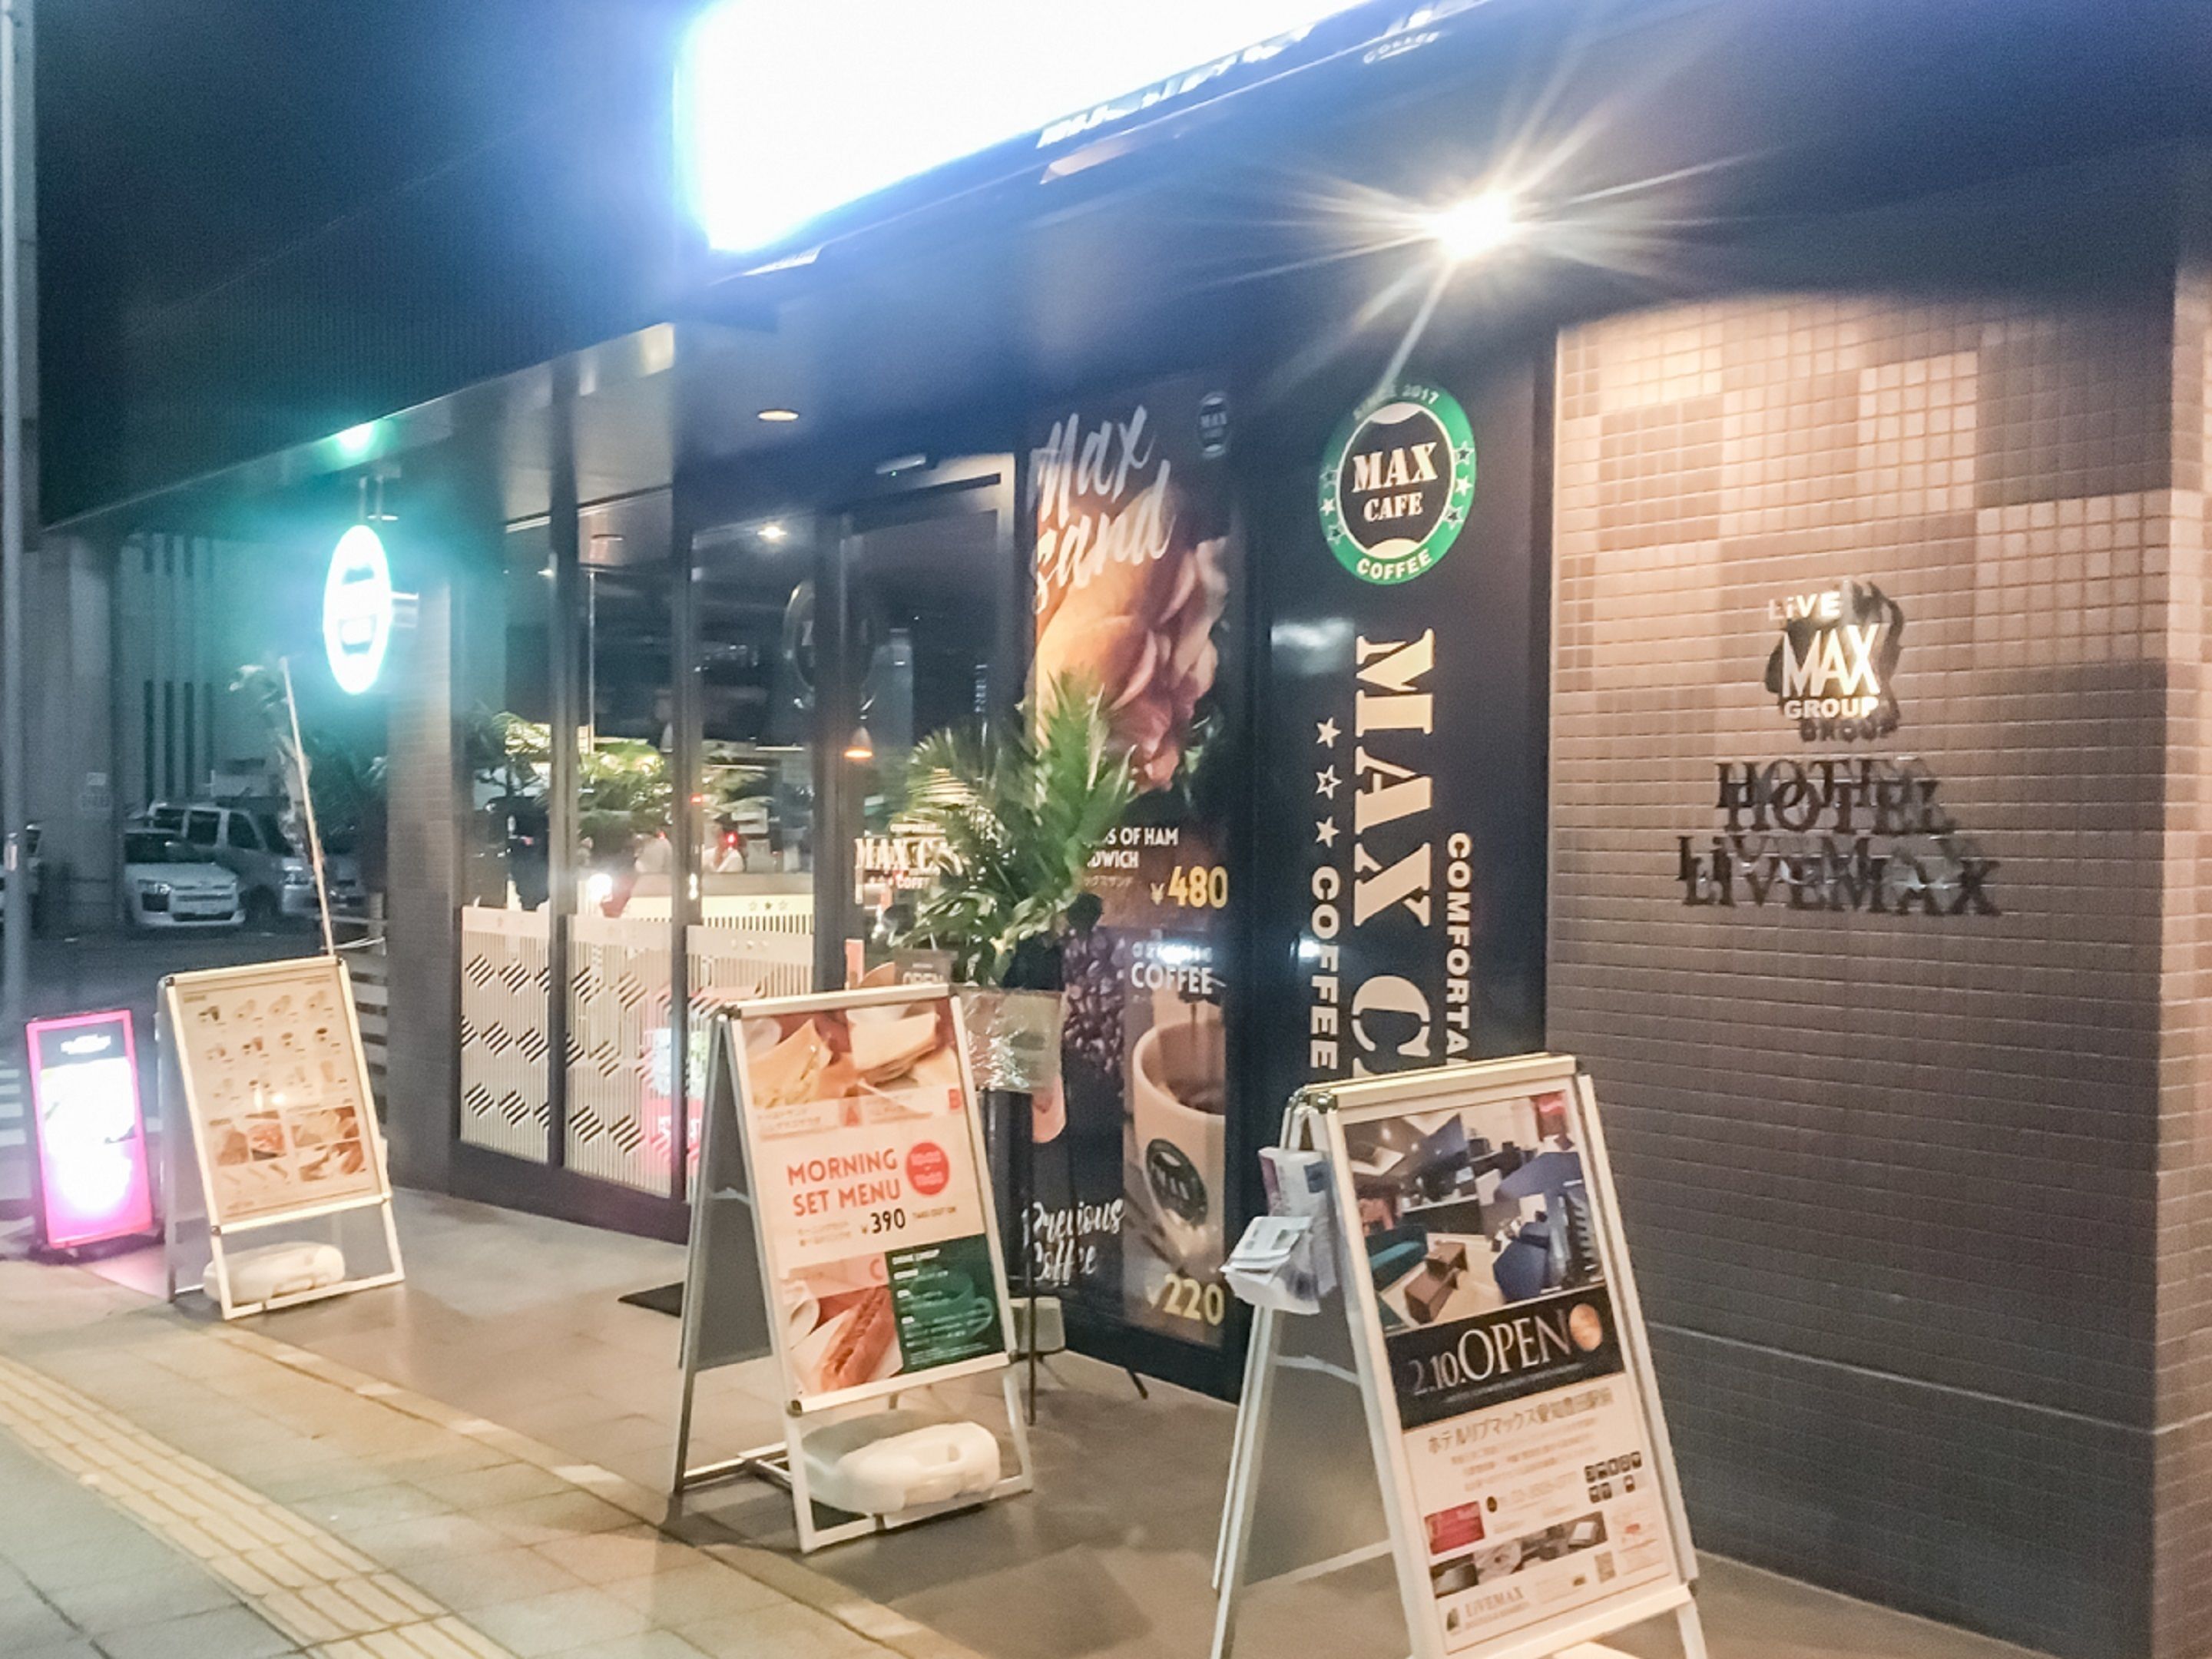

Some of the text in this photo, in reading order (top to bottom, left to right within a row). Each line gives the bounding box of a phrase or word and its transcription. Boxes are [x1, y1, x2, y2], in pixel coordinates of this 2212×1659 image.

[1352, 442, 1439, 493] MAX
[1363, 492, 1424, 522] CAFE
[1356, 548, 1433, 580] COFFEE
[1781, 623, 1880, 697] MAX
[1783, 696, 1880, 720] GROUP
[1354, 628, 1435, 927] MAX
[1714, 757, 1955, 834] HOTEL
[1120, 826, 1142, 846] OF
[1144, 826, 1180, 846] HAM
[1311, 866, 1339, 1070] COFFEE
[1445, 832, 1472, 1065] COMFORTA
[1131, 961, 1214, 995] COFFEE
[786, 1147, 899, 1187] MORNING
[792, 1189, 830, 1217] SET
[838, 1178, 901, 1209] MENU
